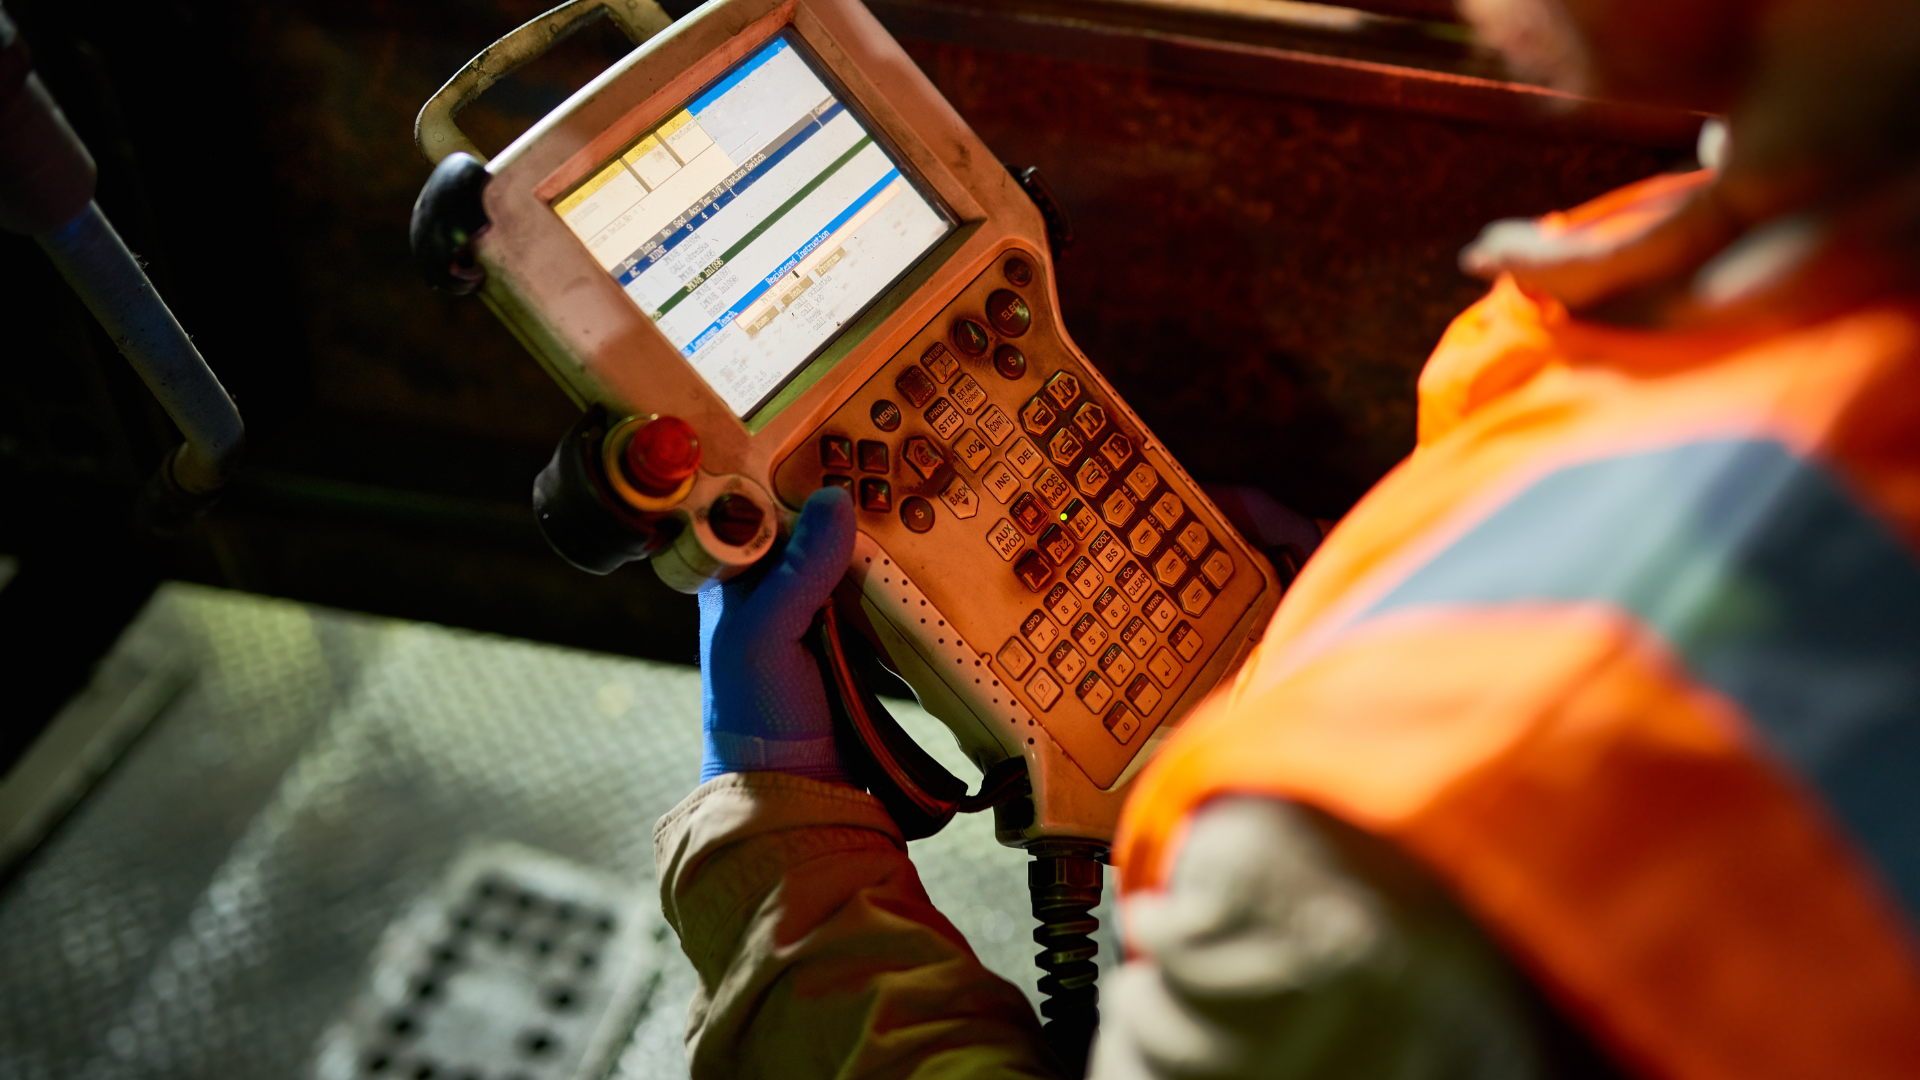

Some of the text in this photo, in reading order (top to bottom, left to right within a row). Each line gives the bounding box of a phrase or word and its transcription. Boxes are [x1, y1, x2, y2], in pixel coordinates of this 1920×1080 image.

[670, 120, 679, 129] PC
[662, 228, 671, 237] No
[674, 216, 686, 228] Spd
[689, 204, 701, 215] Acc
[712, 186, 724, 198] J/E
[745, 152, 766, 170] Switch
[648, 245, 667, 263] JOINT
[686, 223, 694, 231] 9
[700, 212, 708, 220] 4
[766, 229, 829, 285] Registered Instruction
[818, 253, 840, 273] Program
[670, 260, 685, 274] CALL
[793, 275, 831, 309] call ochistka
[709, 301, 726, 317] BREAK
[799, 293, 825, 316] call job
[999, 299, 1023, 323] ELECT
[754, 315, 769, 328] Pose
[806, 308, 822, 323] break
[812, 317, 826, 331] call
[970, 333, 979, 343] A
[693, 330, 730, 363] Instruction:
[924, 344, 944, 363] INTERP
[1008, 356, 1017, 365] S
[732, 375, 749, 391] pause
[737, 381, 756, 398] delay
[743, 370, 782, 405] call obrezka
[957, 380, 975, 399] EXT AXIS
[877, 405, 897, 426] MENU
[929, 400, 948, 419] PROG
[940, 412, 960, 432] STEP
[990, 416, 1004, 431] CONT
[1069, 425, 1077, 433] 2
[1018, 448, 1034, 464] DEL
[1095, 455, 1103, 463] 3
[995, 473, 1010, 489] INS
[1042, 474, 1059, 492] POS
[950, 485, 969, 505] BACK
[1049, 482, 1067, 503] MOD
[1121, 486, 1129, 494] 4
[914, 508, 925, 519] S
[1147, 516, 1155, 524] 5
[1077, 515, 1092, 531] CLn
[995, 525, 1012, 544] AUX
[1093, 533, 1110, 551] TOOL
[1002, 533, 1021, 554] MOD
[1055, 540, 1070, 557] CL2
[1173, 545, 1181, 553] 6
[1106, 549, 1118, 562] BS
[1072, 560, 1087, 576] TMR
[1123, 567, 1133, 579] CC
[1083, 579, 1092, 588] 9
[1128, 574, 1148, 596] CLEAR
[1050, 587, 1064, 602] ACC
[1101, 593, 1112, 606] WS
[1061, 606, 1069, 614] 8
[1074, 601, 1081, 609] E
[1122, 604, 1129, 612] C
[1147, 594, 1161, 611] WRK
[1110, 609, 1118, 618] 6
[1160, 610, 1168, 619] C
[1026, 615, 1040, 630] SPD
[1079, 620, 1090, 632] WX
[1123, 619, 1142, 640] CL AUX
[1038, 633, 1046, 641] 7
[1088, 636, 1097, 645] 5
[1100, 631, 1107, 639] B
[1176, 628, 1186, 639] J/E
[1139, 637, 1147, 646] 3
[1056, 647, 1066, 659] OX
[1105, 649, 1117, 664] OFF
[1065, 663, 1074, 672] 4
[1077, 658, 1085, 666] A
[1117, 664, 1126, 673] 2
[1083, 678, 1094, 690] ON
[1095, 692, 1103, 700] 1
[1123, 722, 1131, 731] 0
